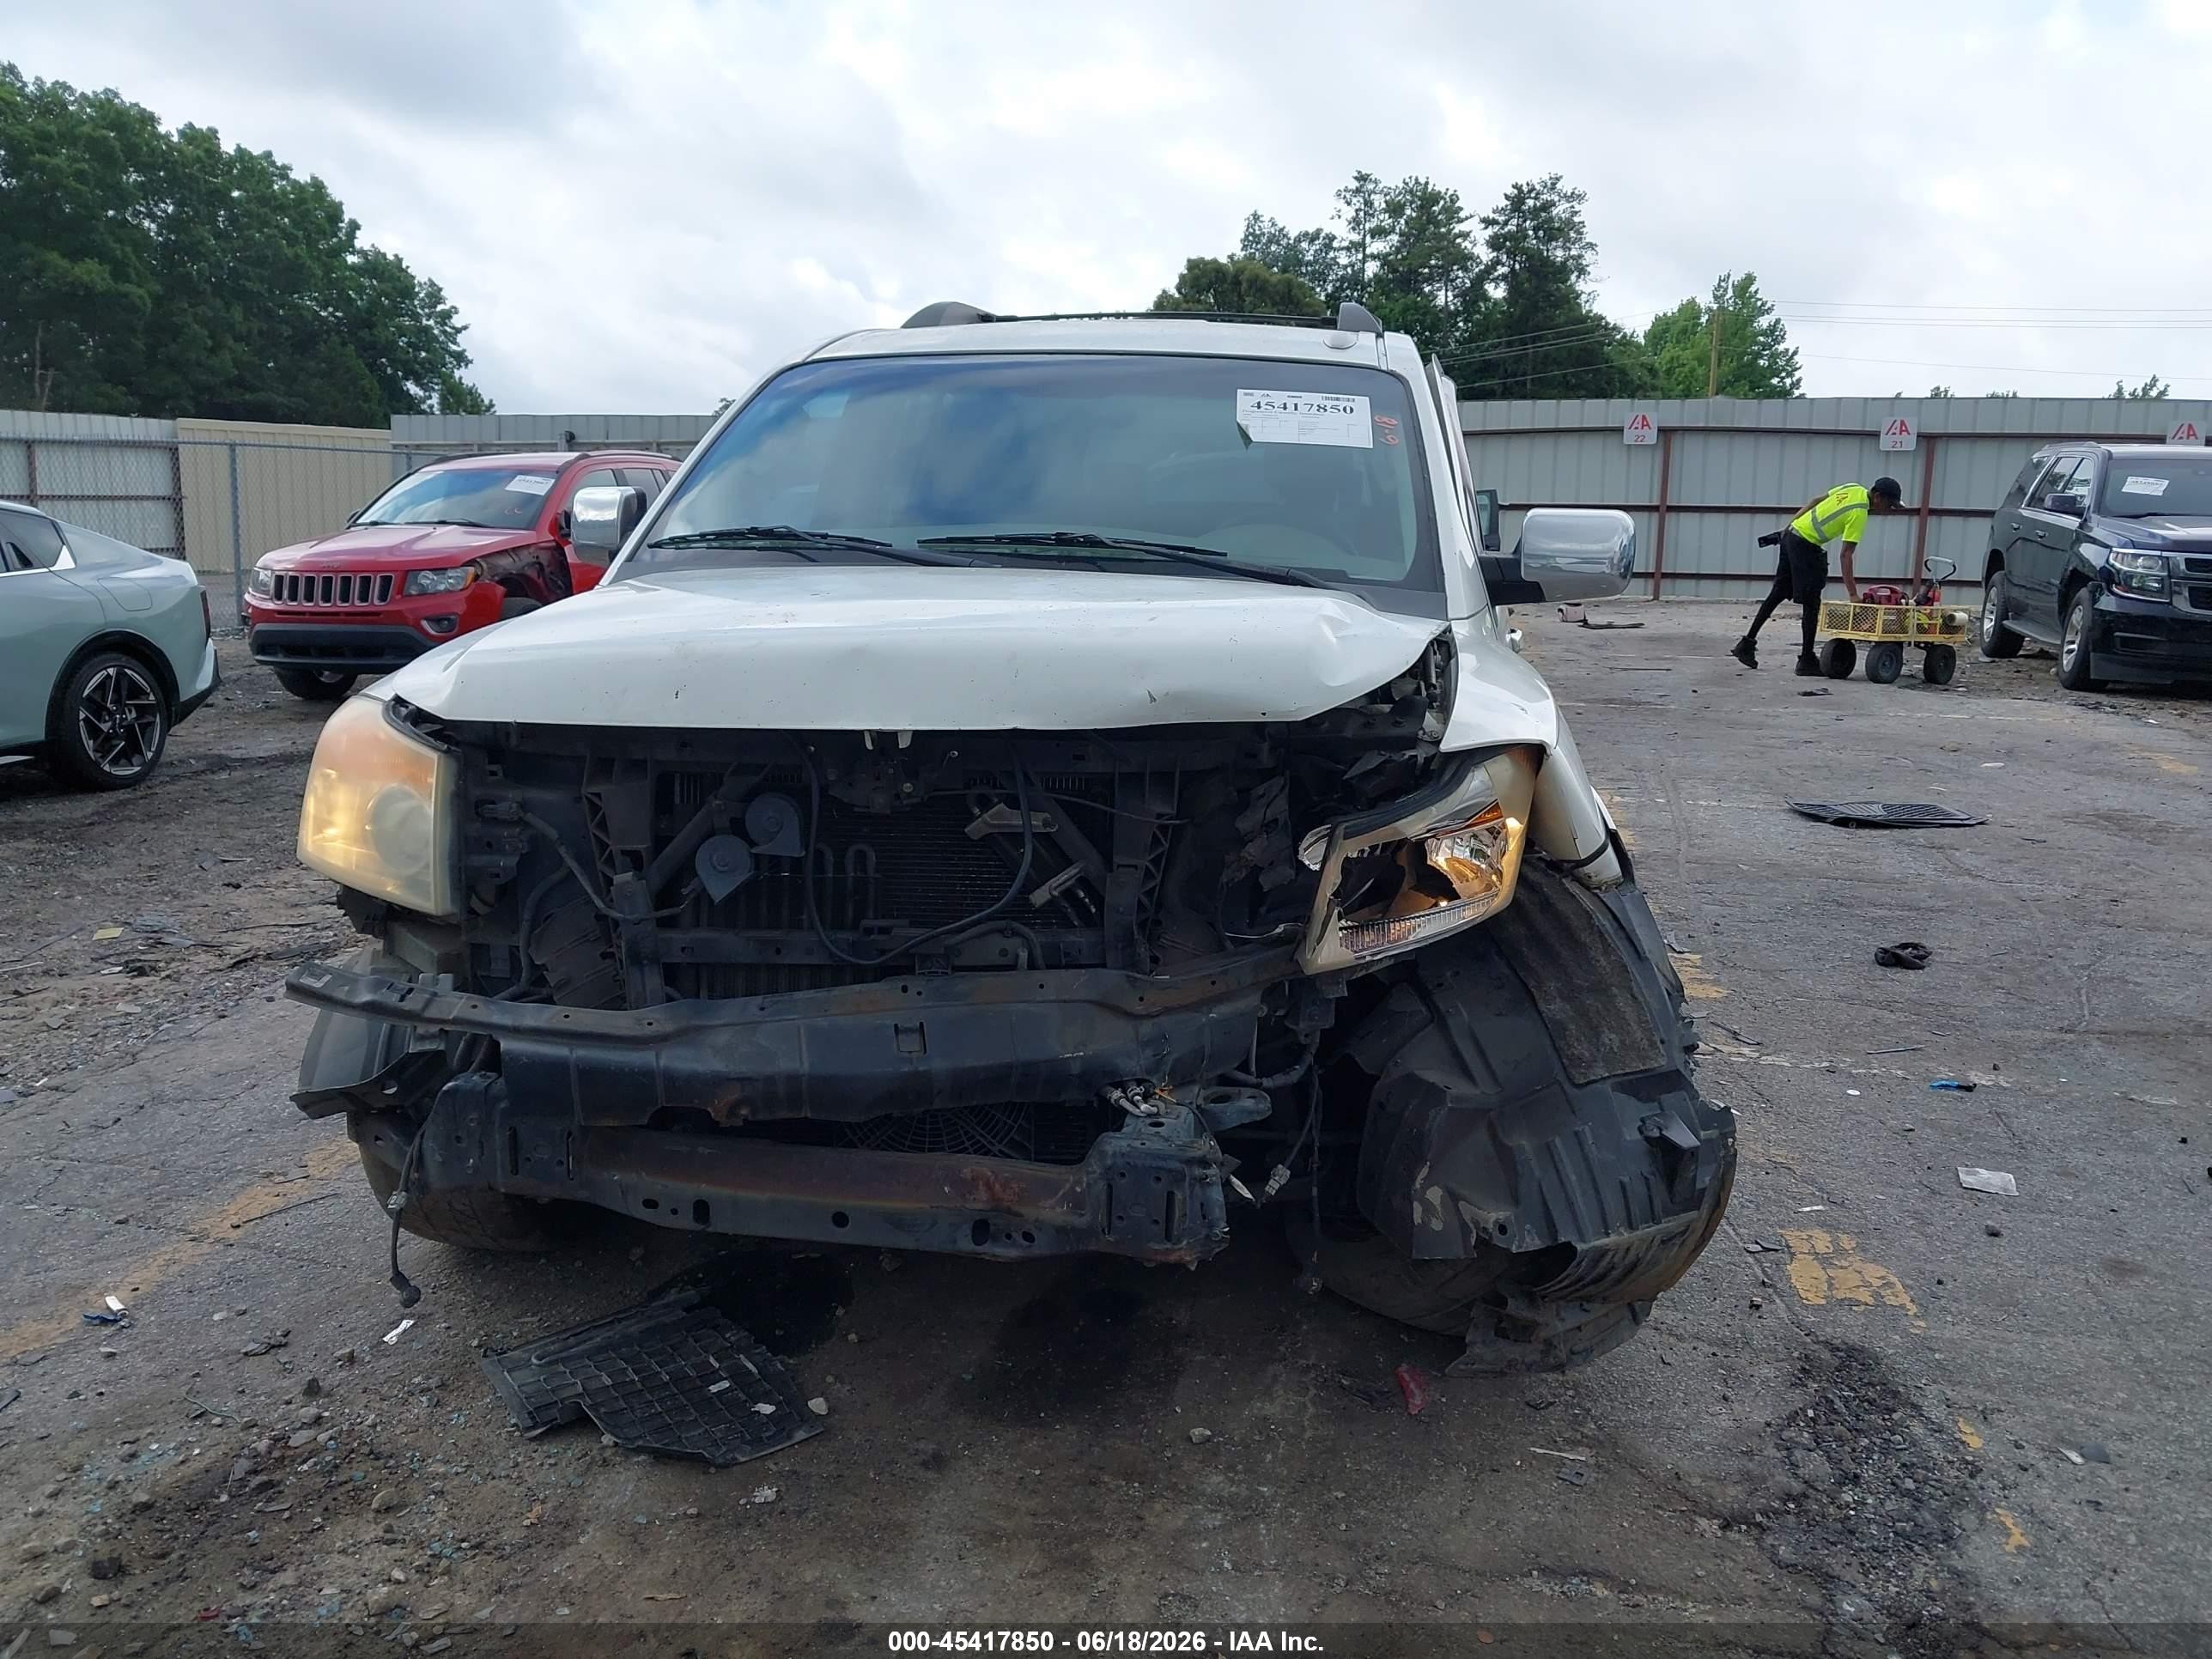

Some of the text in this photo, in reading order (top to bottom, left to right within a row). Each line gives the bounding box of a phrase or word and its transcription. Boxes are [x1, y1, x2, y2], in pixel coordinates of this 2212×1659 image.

[1250, 400, 1354, 415] 45417850
[1634, 434, 1646, 443] 22
[1891, 440, 1903, 449] 21
